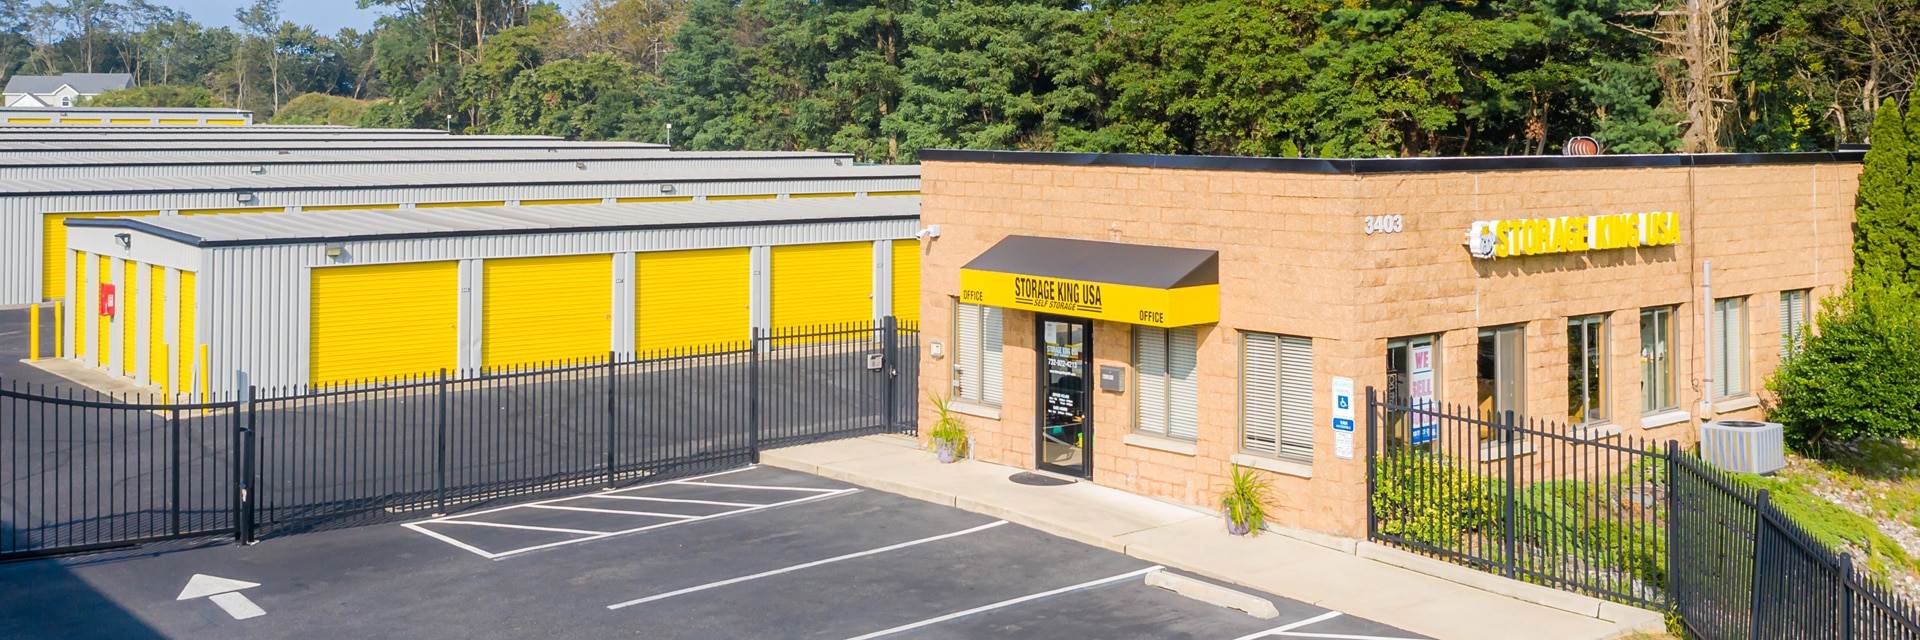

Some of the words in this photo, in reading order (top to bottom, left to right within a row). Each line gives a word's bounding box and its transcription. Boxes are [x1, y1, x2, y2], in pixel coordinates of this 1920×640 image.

[1364, 214, 1403, 235] 3403
[1495, 216, 1590, 258] STORAGE
[1594, 213, 1640, 249] KING
[1645, 211, 1681, 246] USA
[963, 289, 983, 302] OFFICE
[1015, 277, 1055, 301] STORAGE
[1057, 281, 1080, 303] KING
[1083, 284, 1102, 306] USA
[1033, 298, 1048, 308] SELF
[1049, 300, 1076, 311] STORAGE
[1139, 310, 1164, 324] OFFICE
[1415, 351, 1428, 368] WE
[1412, 379, 1432, 397] SELL
